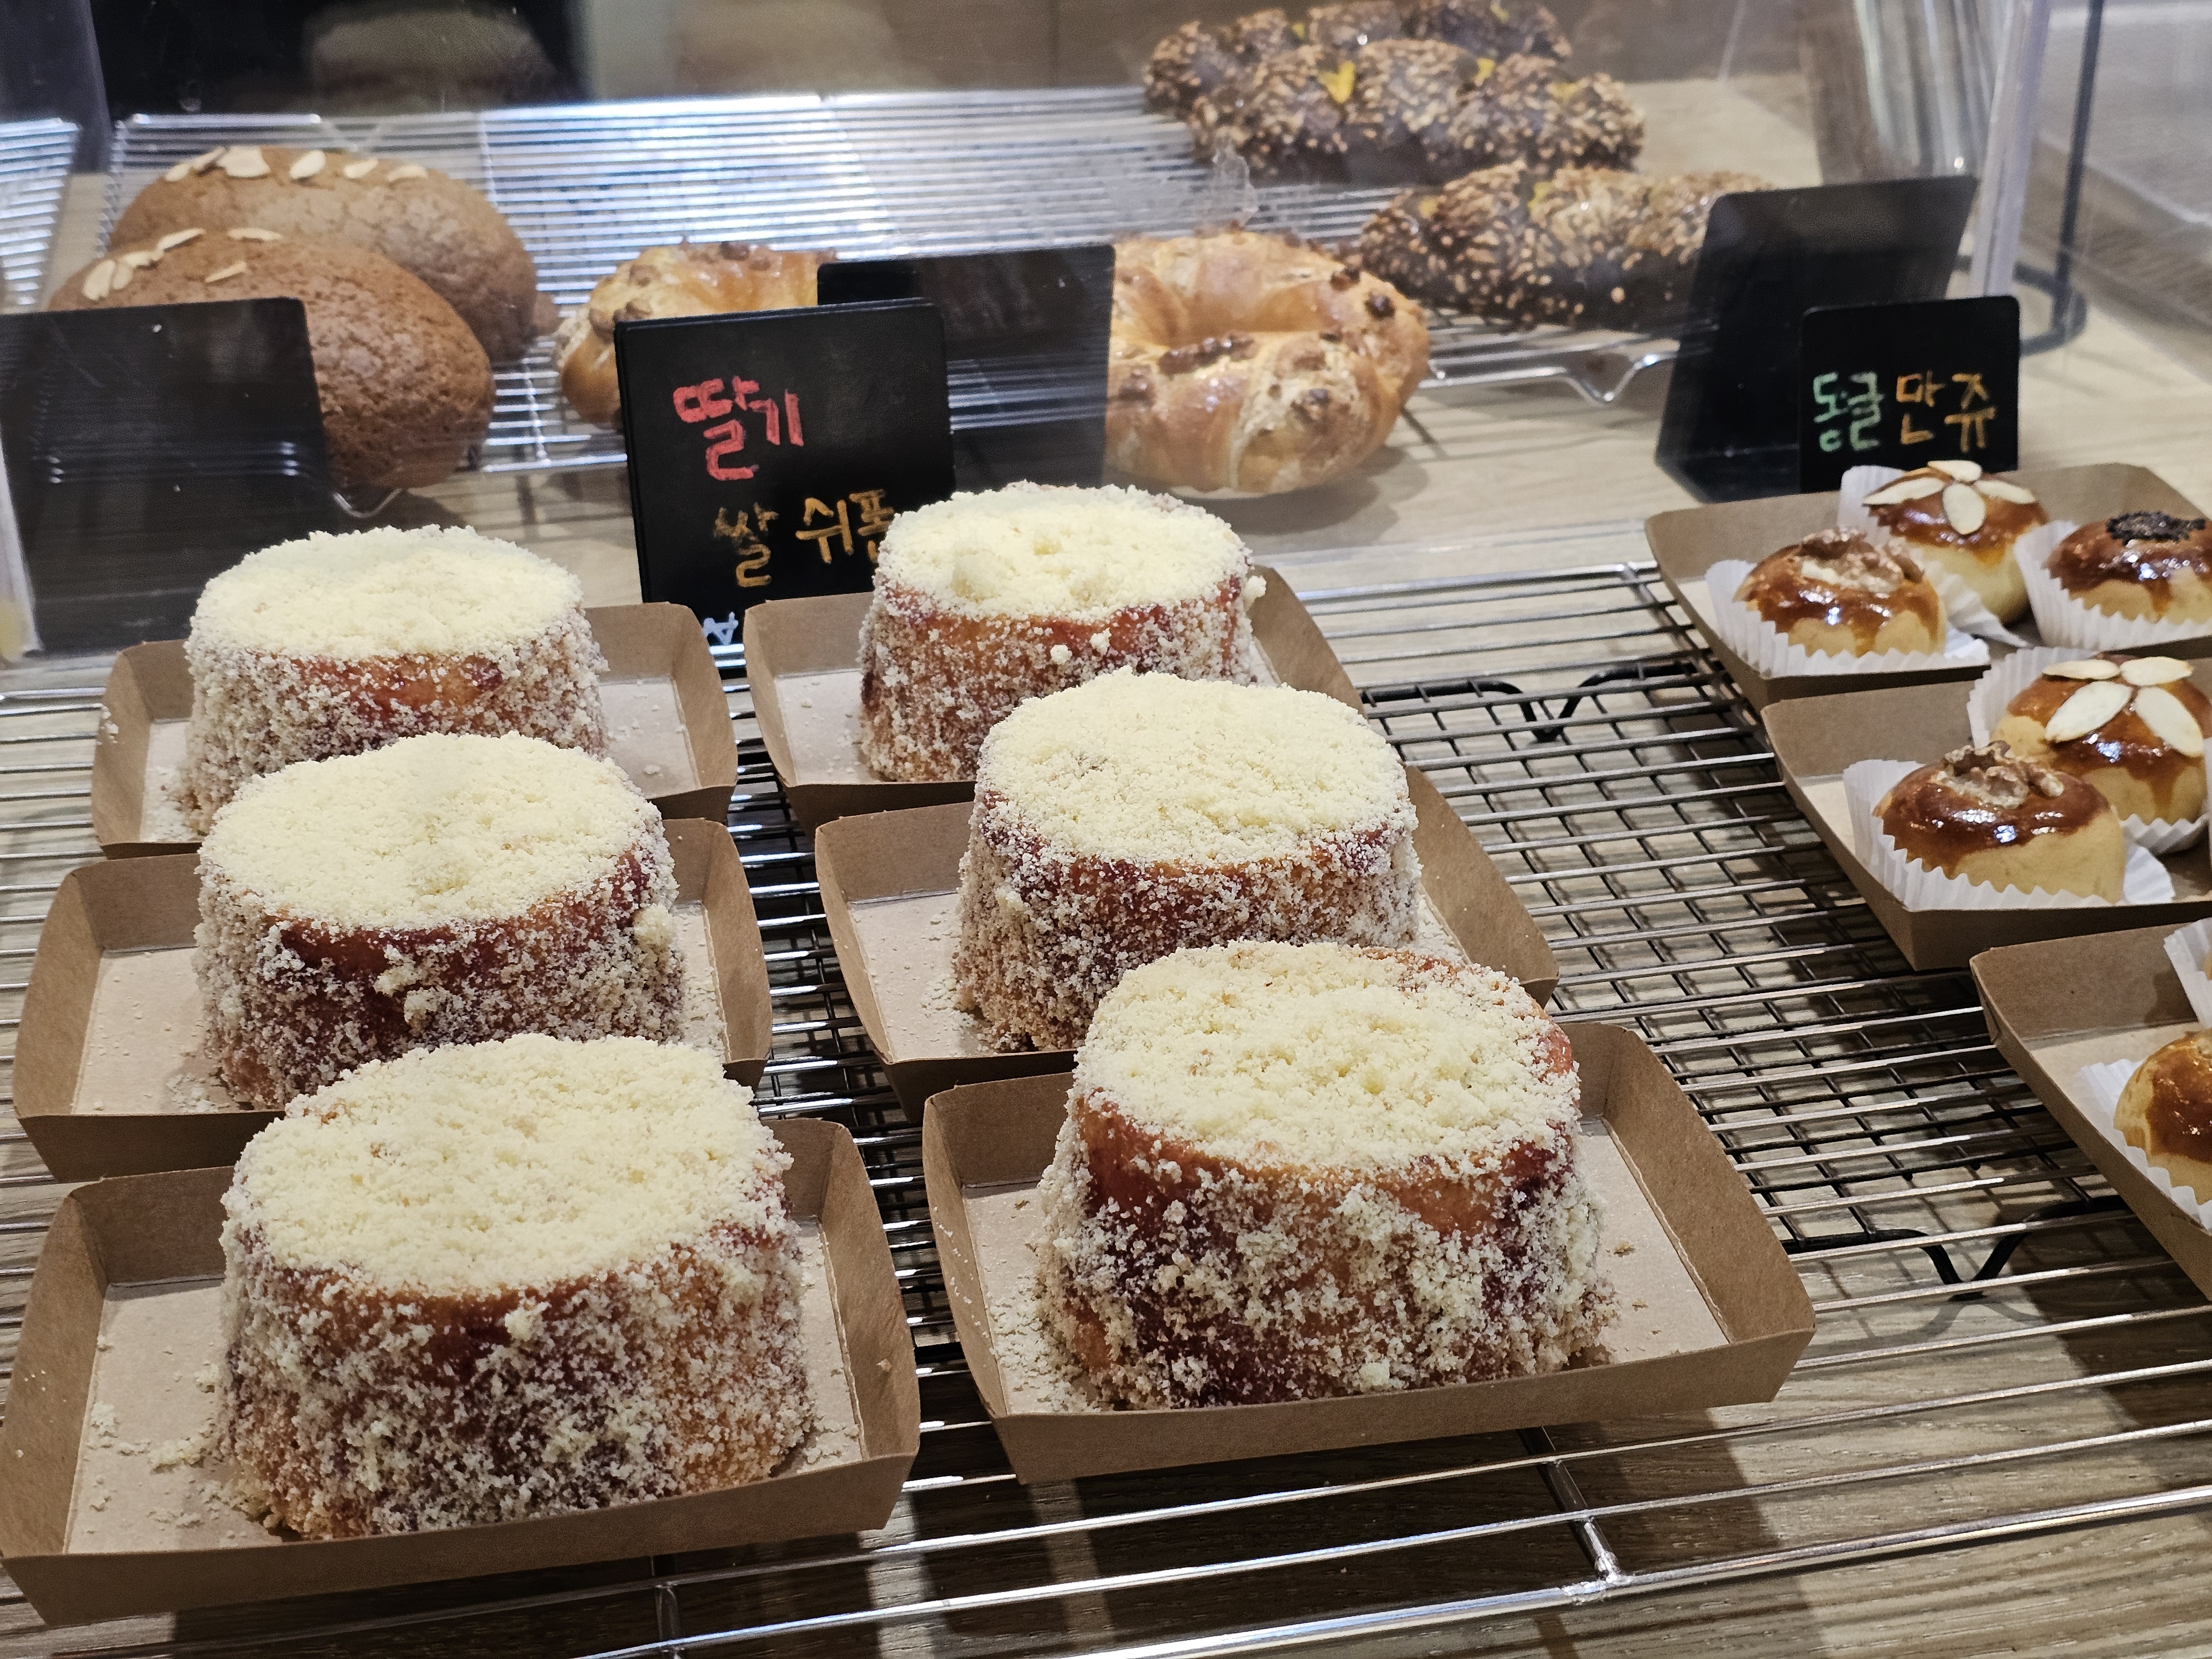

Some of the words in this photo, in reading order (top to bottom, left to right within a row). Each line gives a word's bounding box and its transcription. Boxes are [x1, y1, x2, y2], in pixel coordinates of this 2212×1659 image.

[672, 375, 805, 482] 딸기
[1812, 370, 1885, 453] 동글
[1896, 369, 1997, 453] 만쥬
[712, 502, 779, 588] 쌀
